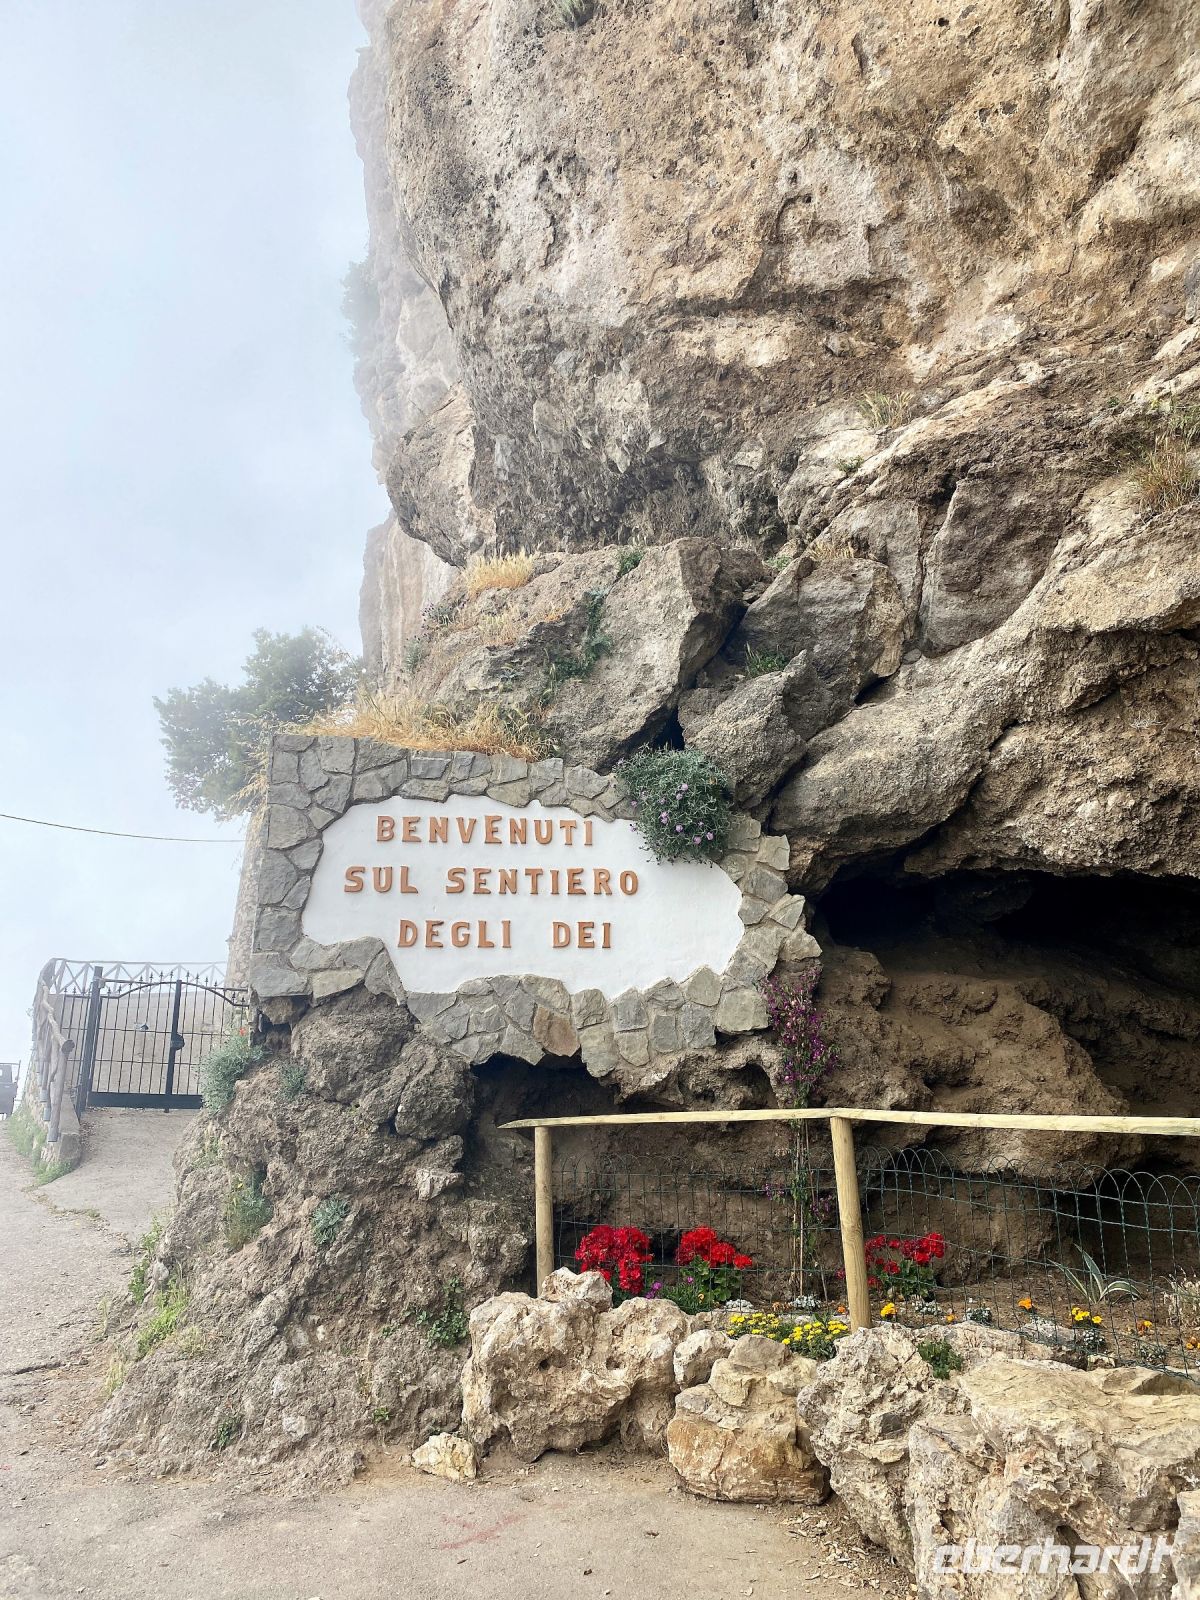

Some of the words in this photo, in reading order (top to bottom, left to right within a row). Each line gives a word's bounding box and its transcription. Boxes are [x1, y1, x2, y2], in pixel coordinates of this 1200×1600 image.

[376, 815, 593, 846] BENVENUTI
[344, 865, 419, 894] SUL
[445, 867, 639, 896] SENTIERO
[397, 919, 512, 949] DEGLI
[552, 921, 611, 949] DEI
